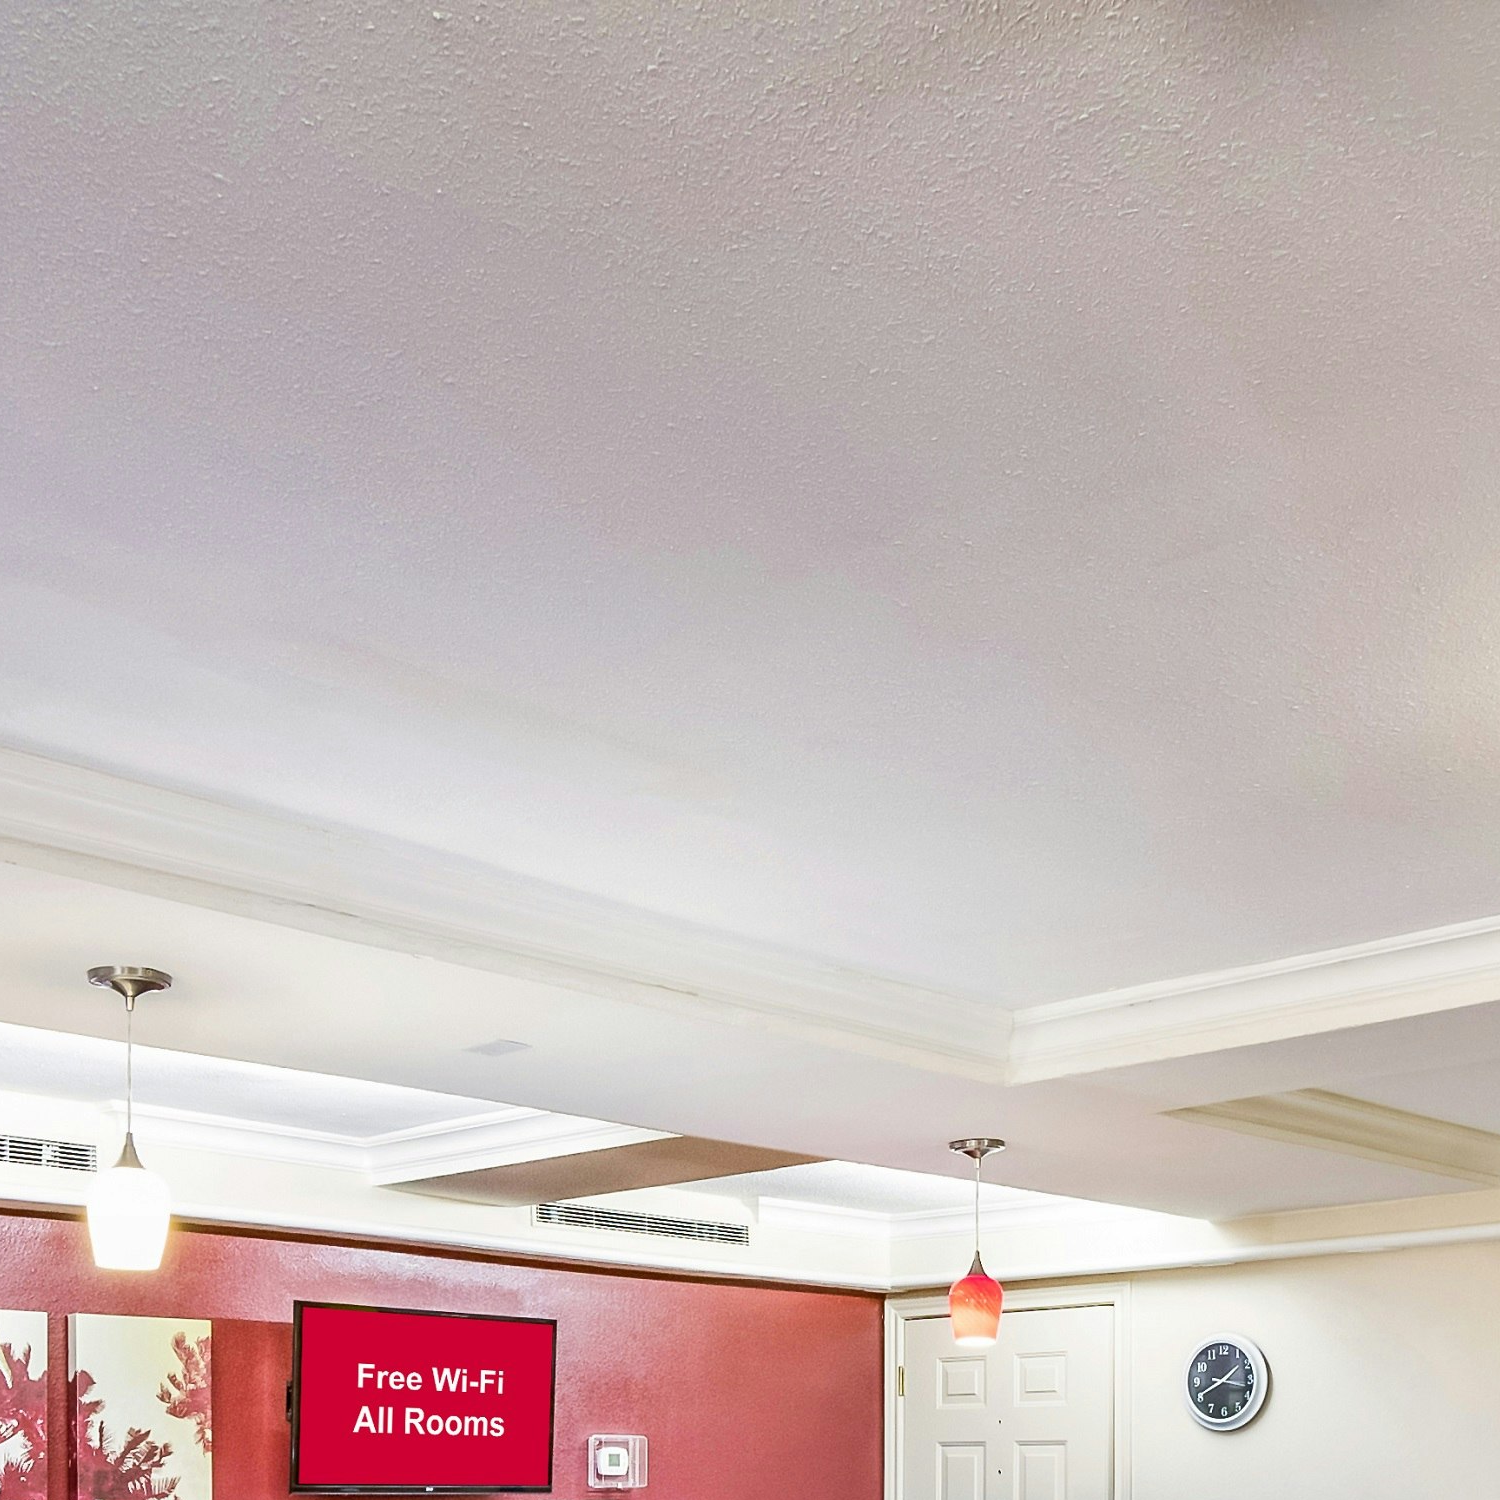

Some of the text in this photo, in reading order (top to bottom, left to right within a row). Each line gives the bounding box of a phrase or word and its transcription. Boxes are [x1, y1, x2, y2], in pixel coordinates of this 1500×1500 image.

[1207, 1349, 1216, 1360] 11
[1218, 1345, 1230, 1355] 12
[1235, 1348, 1240, 1359] 1
[1197, 1362, 1207, 1373] 10
[1244, 1359, 1251, 1369] 2
[357, 1362, 505, 1395] Free Wi-Fi
[1193, 1377, 1201, 1387] 9
[1247, 1374, 1254, 1385] 3
[1197, 1392, 1204, 1402] 8
[1244, 1390, 1251, 1401] 4
[1208, 1403, 1215, 1413] 7
[1221, 1406, 1228, 1417] 6
[1235, 1402, 1242, 1412] 5
[352, 1405, 506, 1438] All Rooms
